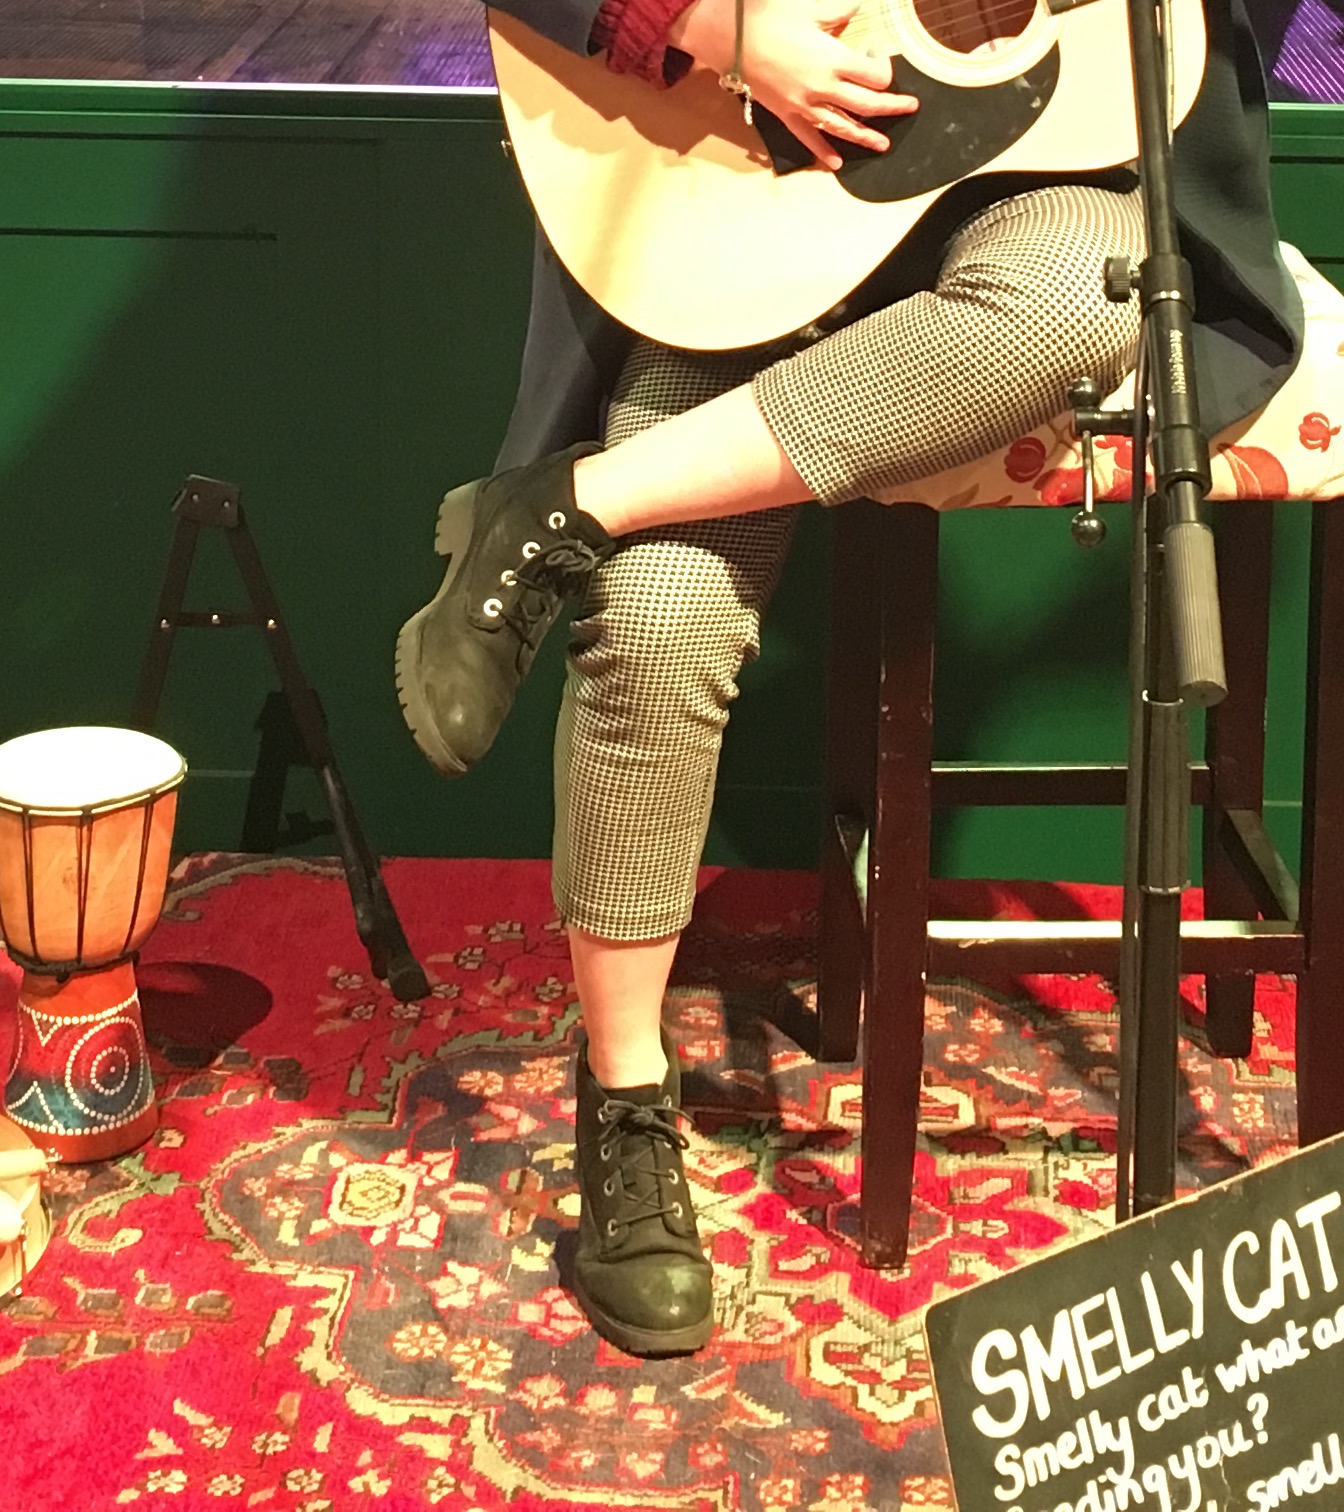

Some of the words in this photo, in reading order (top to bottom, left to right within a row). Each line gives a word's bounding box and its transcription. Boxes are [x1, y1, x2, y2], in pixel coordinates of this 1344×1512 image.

[971, 1248, 1204, 1439] SMELLY
[994, 1409, 1135, 1501] Smelly
[1137, 1366, 1209, 1432] cat
[1215, 1319, 1310, 1393] what
[1167, 1392, 1269, 1512] you?
